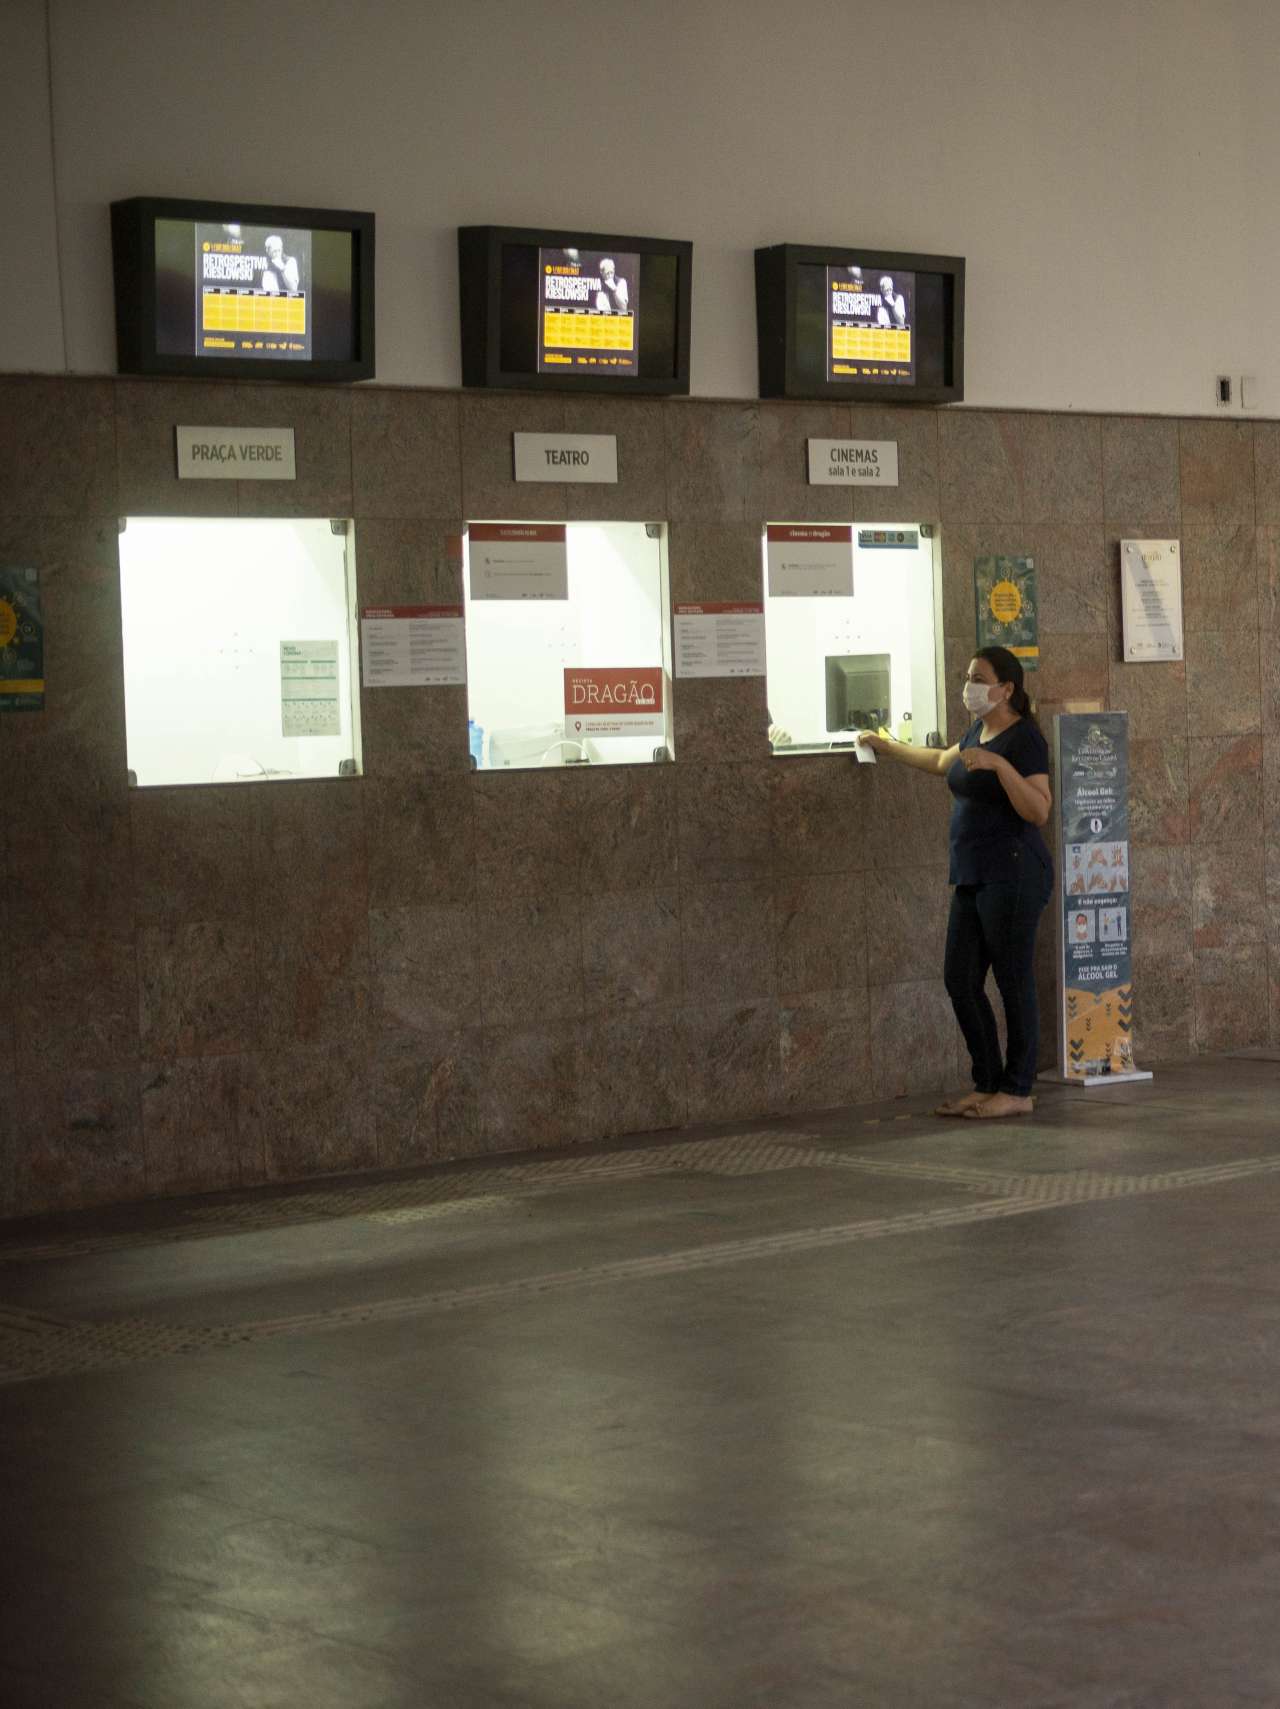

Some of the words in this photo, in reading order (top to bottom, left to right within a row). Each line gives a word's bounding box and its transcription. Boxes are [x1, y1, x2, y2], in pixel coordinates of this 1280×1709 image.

[203, 253, 268, 271] RETROSPECTIVA
[203, 265, 253, 281] KIESLOWSKI
[545, 275, 602, 291] RETROSPECTIVA
[832, 291, 882, 307] RETROSPECTIVA
[192, 444, 237, 464] PRAÇA
[239, 444, 282, 461] VERDE
[544, 449, 590, 465] TEATRO
[830, 448, 878, 463] CINEMAS
[828, 465, 844, 477] sala
[846, 465, 850, 477] 1
[851, 467, 857, 477] e
[858, 465, 873, 477] sala
[874, 466, 881, 478] 2
[572, 680, 655, 704] DRAGÃO
